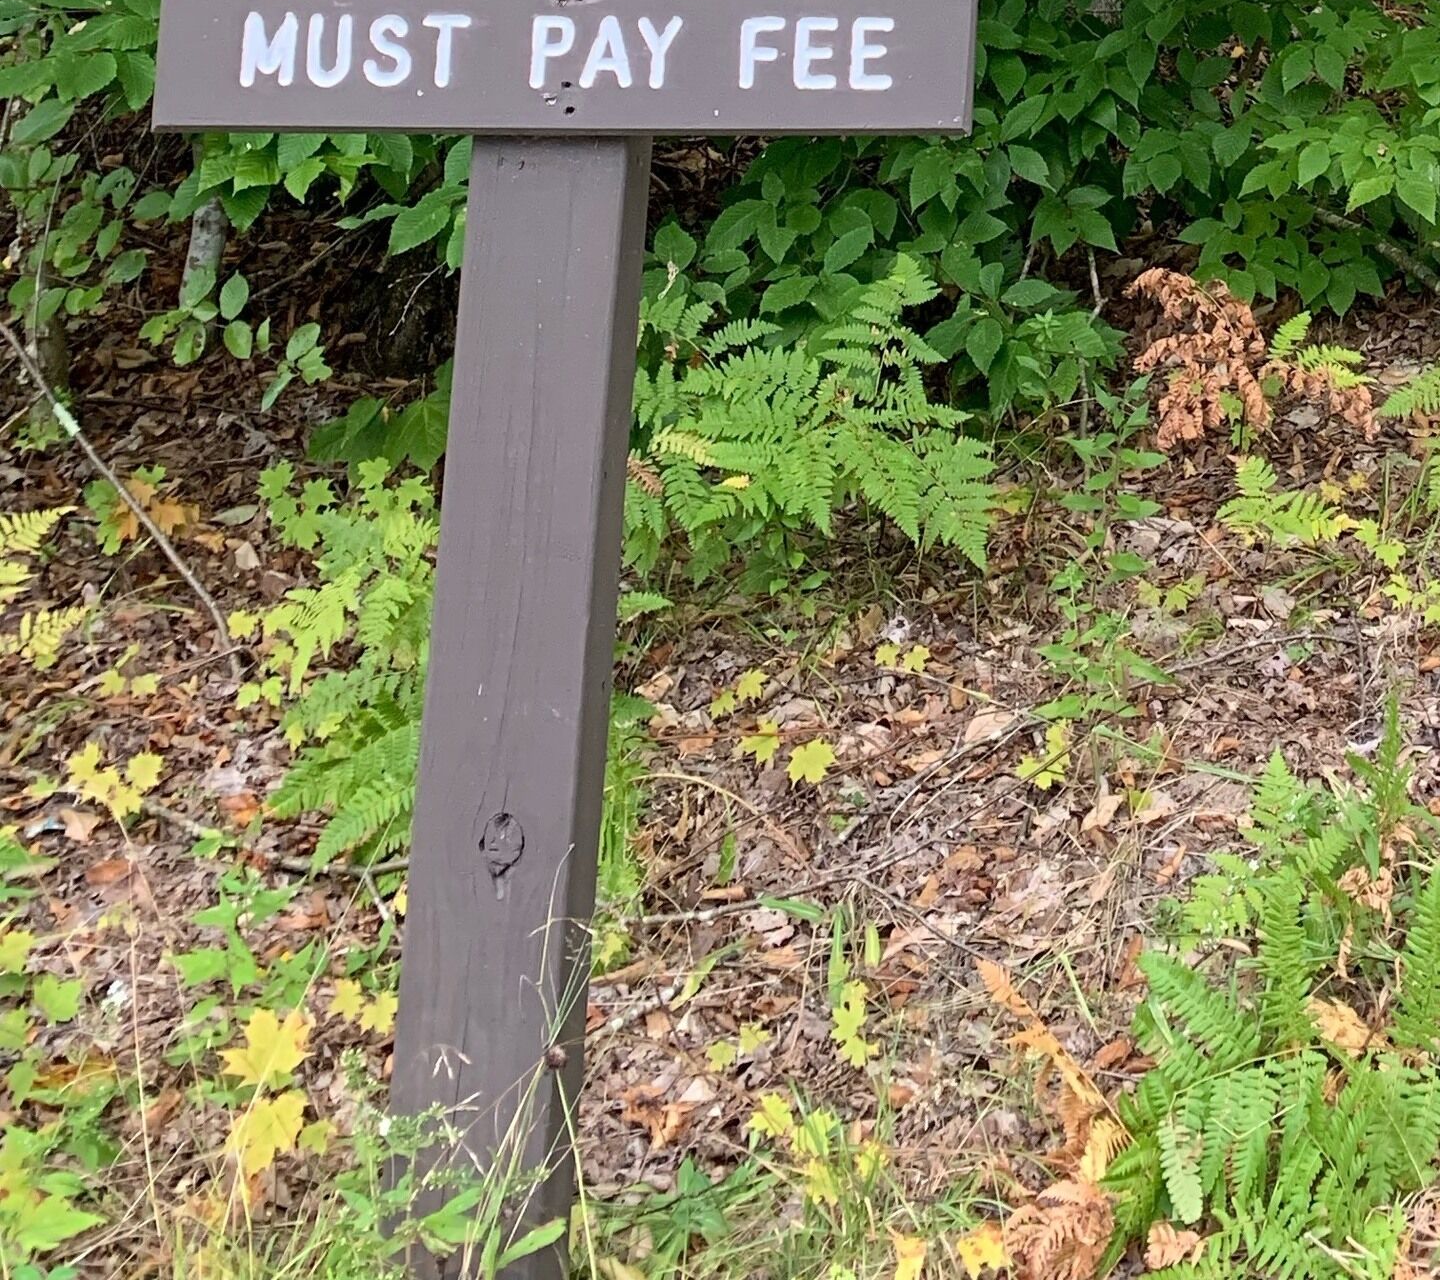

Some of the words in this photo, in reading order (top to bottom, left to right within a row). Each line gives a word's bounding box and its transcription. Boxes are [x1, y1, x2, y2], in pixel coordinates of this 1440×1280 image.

[240, 11, 472, 89] MUST
[528, 14, 684, 91] PAY
[738, 15, 895, 91] FEE
